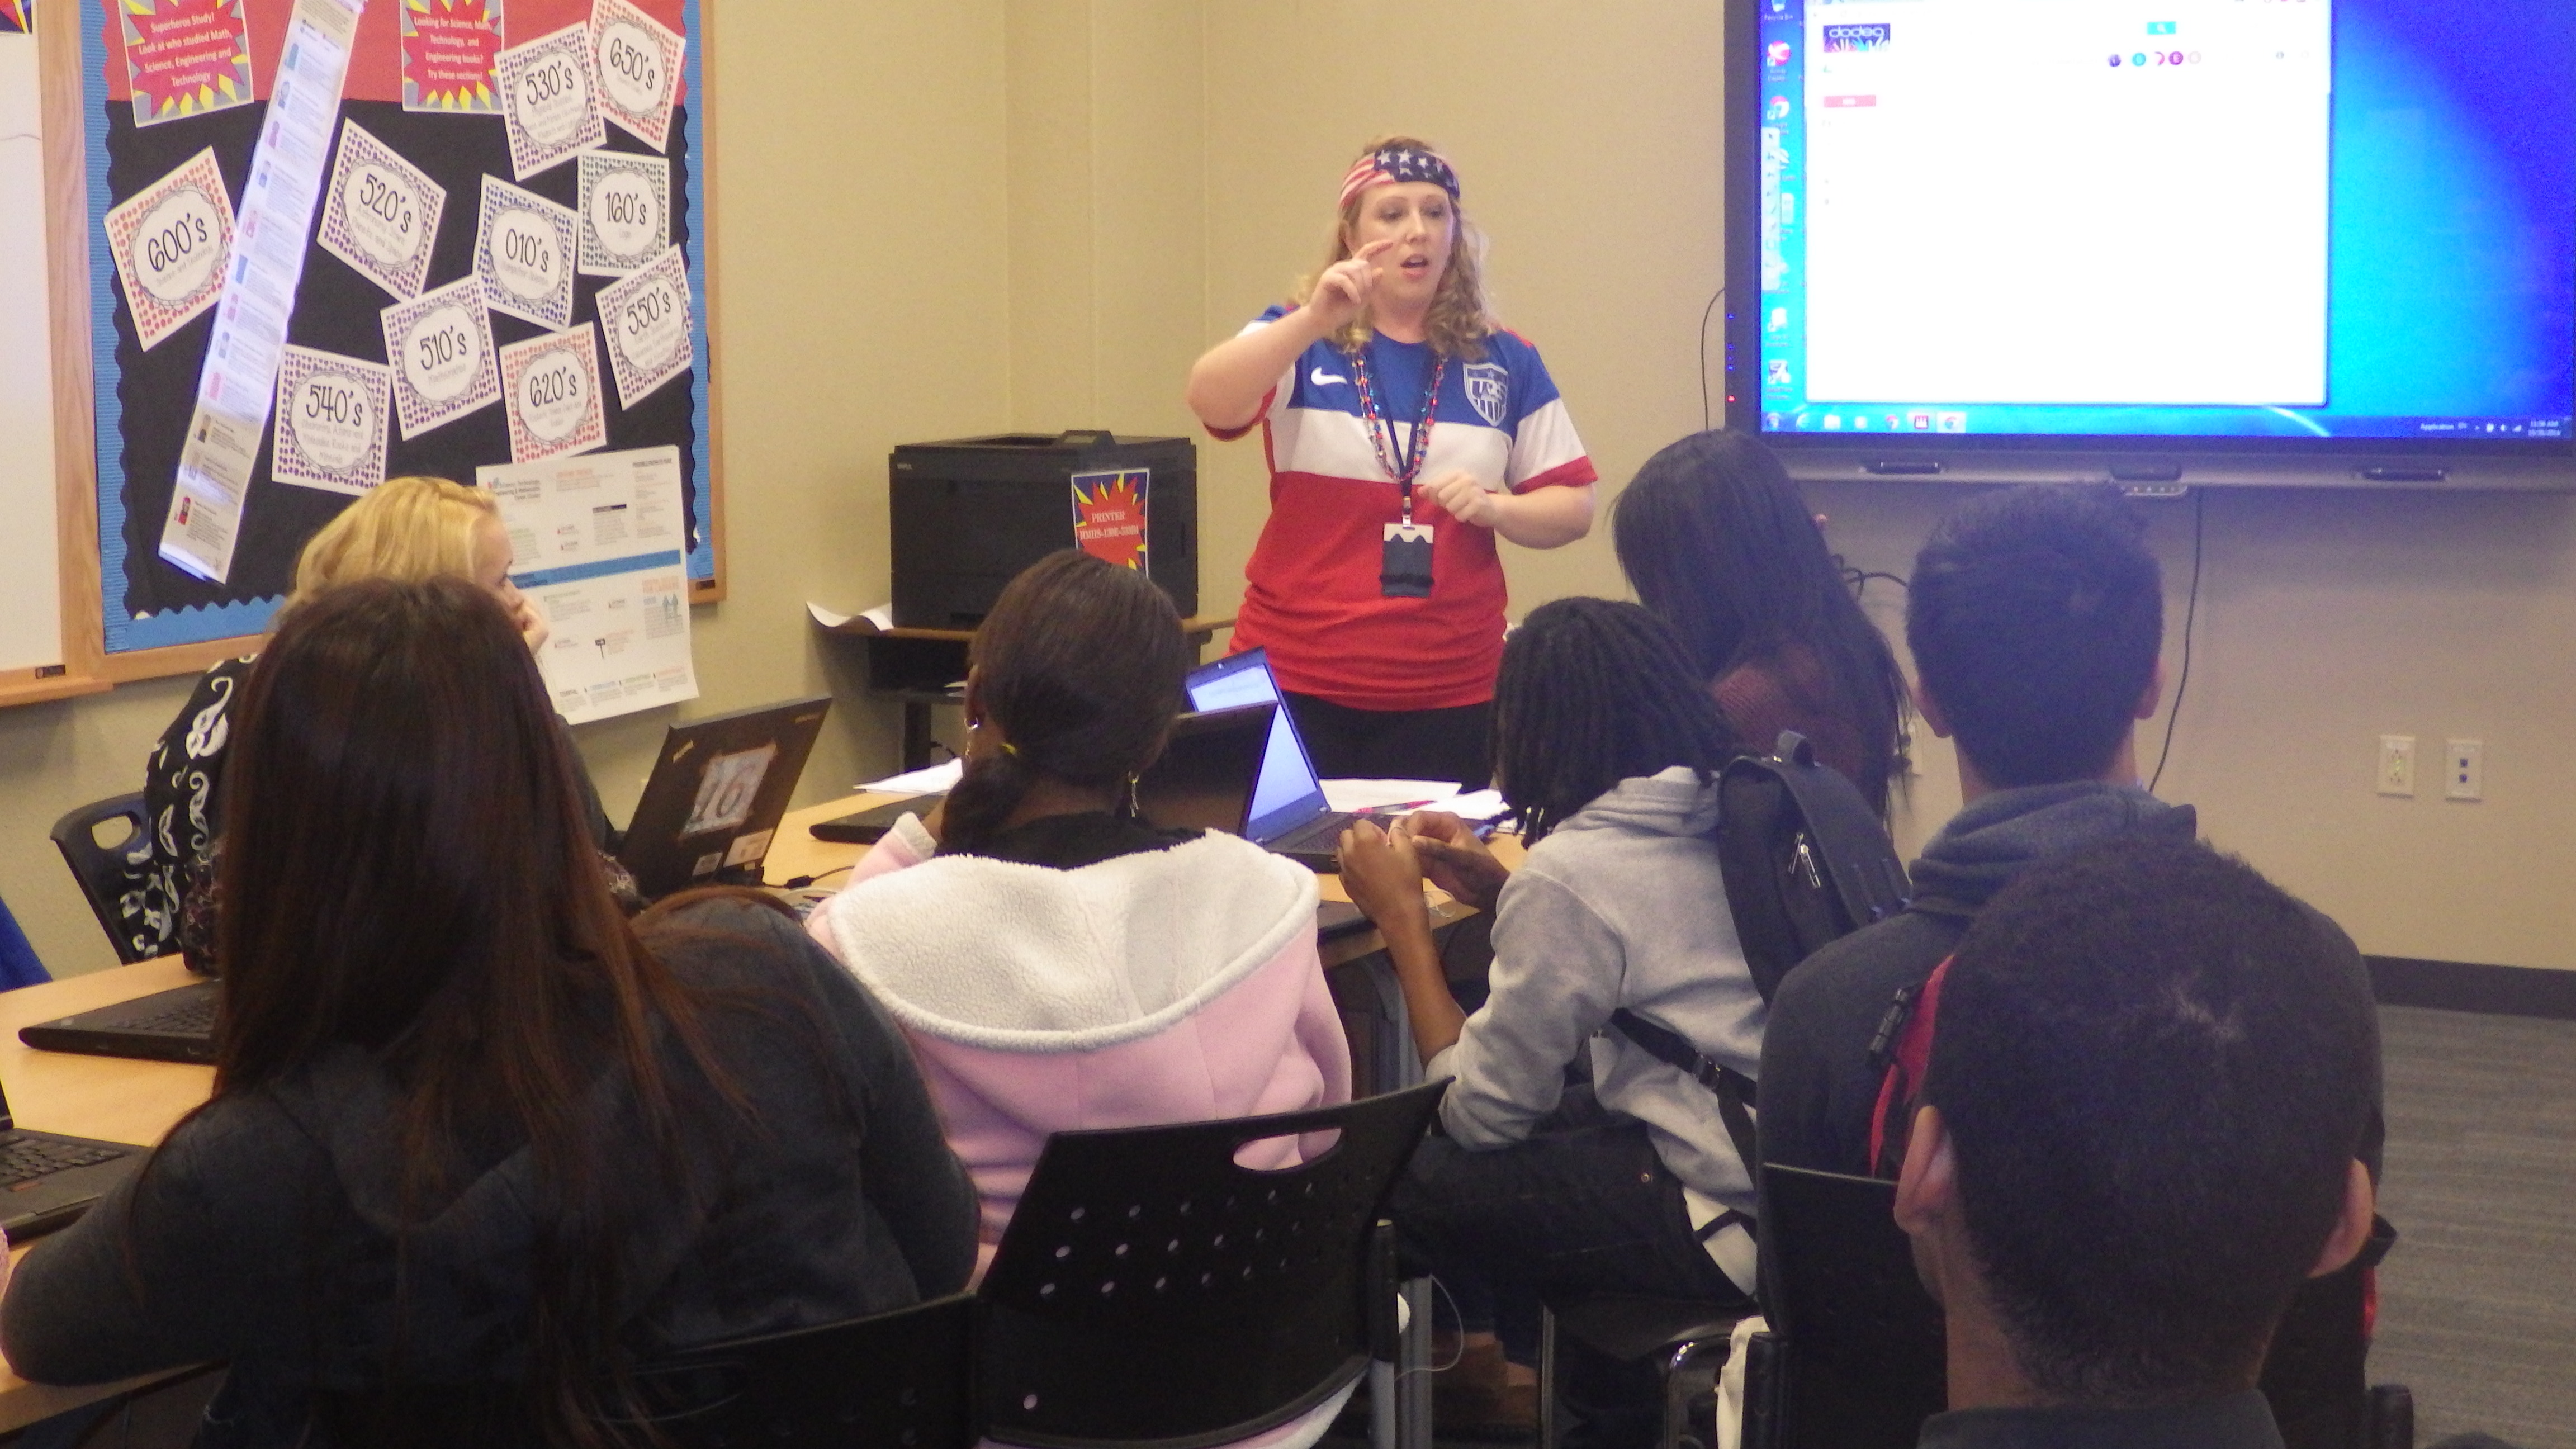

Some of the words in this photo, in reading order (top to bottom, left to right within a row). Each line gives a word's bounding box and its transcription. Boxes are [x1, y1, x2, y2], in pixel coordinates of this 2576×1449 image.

[150, 18, 191, 33] Superheros
[191, 12, 214, 25] Study!
[414, 16, 439, 29] Looking
[440, 17, 449, 27] for
[139, 42, 156, 55] Look
[157, 41, 165, 51] at
[165, 39, 182, 49] who
[183, 31, 210, 45] studied
[210, 28, 233, 40] Math,
[425, 51, 461, 64] Engineering
[467, 37, 479, 46] and
[144, 61, 174, 73] Science,
[175, 51, 217, 68] Engineering
[217, 47, 231, 57] and
[428, 68, 437, 80] Try
[438, 69, 455, 80] these
[610, 37, 655, 91] 650's
[171, 72, 211, 87] Technology
[525, 60, 574, 106] 530's
[359, 173, 411, 234] 520's
[605, 192, 646, 225] 160's
[148, 212, 207, 272] 600's
[506, 228, 549, 273] 010's
[626, 287, 671, 335] 550's
[419, 325, 467, 371] 510's
[529, 366, 577, 408] 620's
[306, 384, 363, 427] 540's
[1091, 510, 1125, 523] PRINTER
